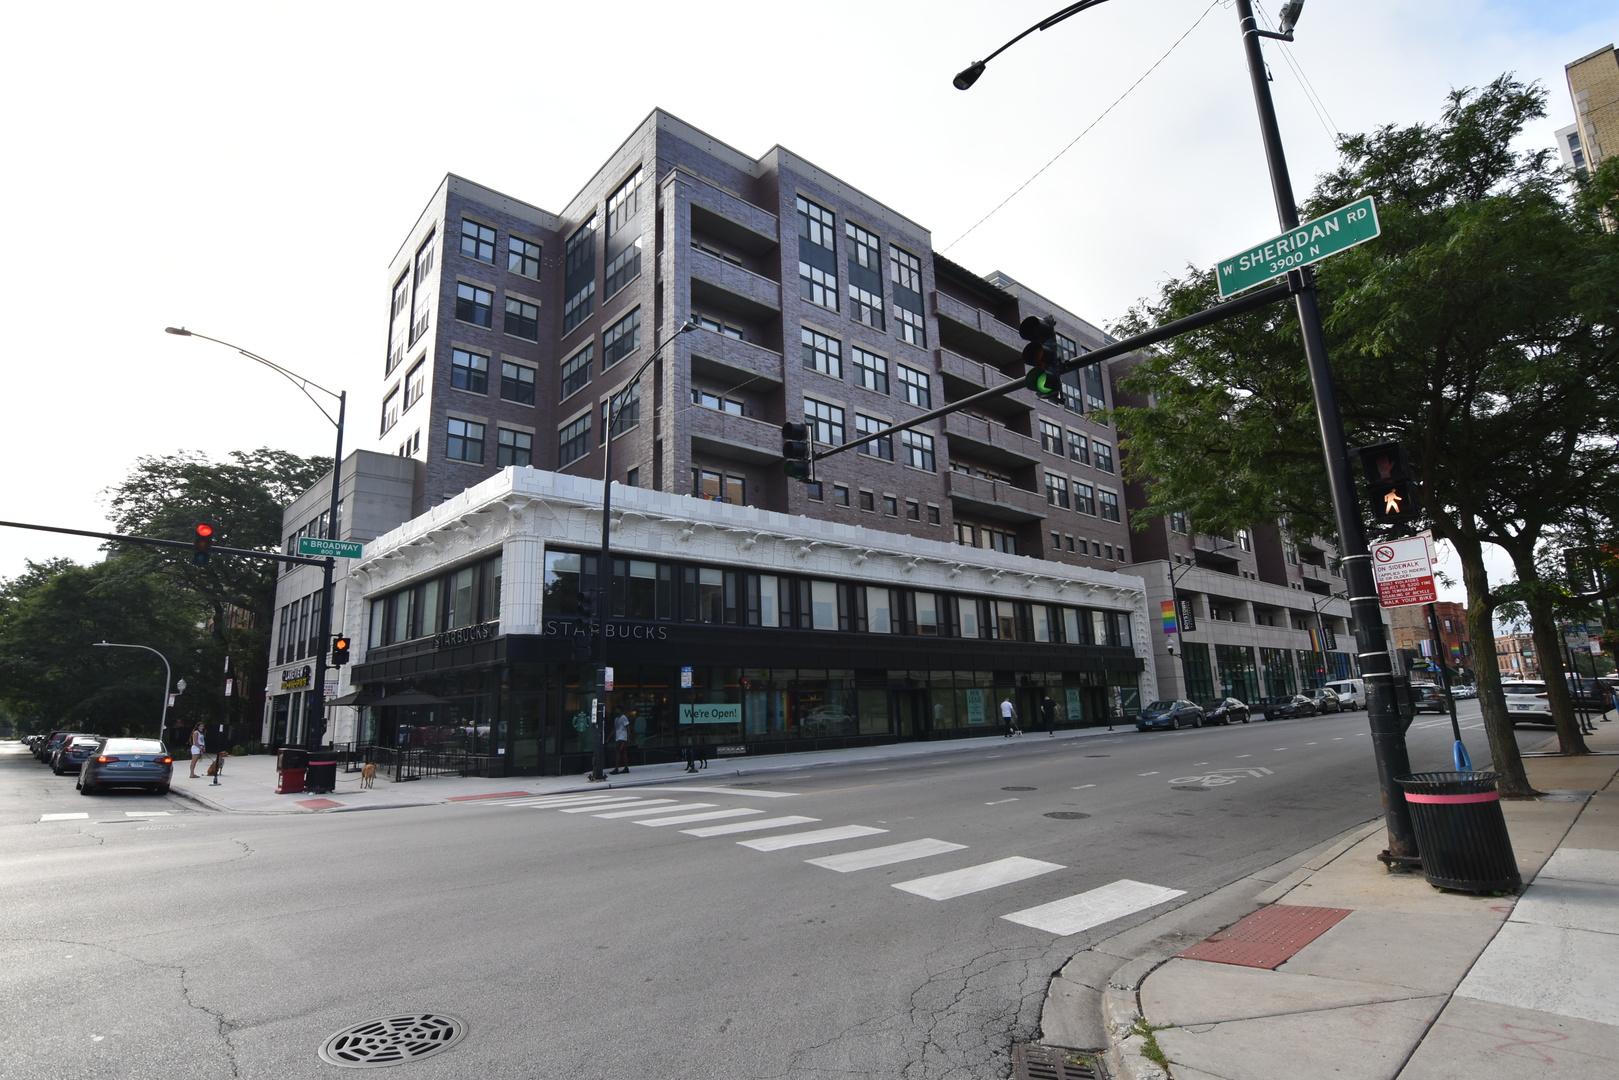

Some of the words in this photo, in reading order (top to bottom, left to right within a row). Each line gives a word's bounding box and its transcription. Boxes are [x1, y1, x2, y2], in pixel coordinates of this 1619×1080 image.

[1222, 264, 1233, 276] W
[1239, 216, 1340, 271] SHERIDAN
[1346, 207, 1367, 224] RD
[1269, 253, 1304, 273] 3900
[1310, 244, 1320, 257] N
[310, 541, 359, 551] BROADWAY
[1389, 561, 1419, 570] SIDEWALK
[434, 623, 488, 648] STARBUCKS
[546, 620, 667, 640] STARBUCKS
[684, 709, 709, 718] We're
[712, 708, 737, 719] Open!
